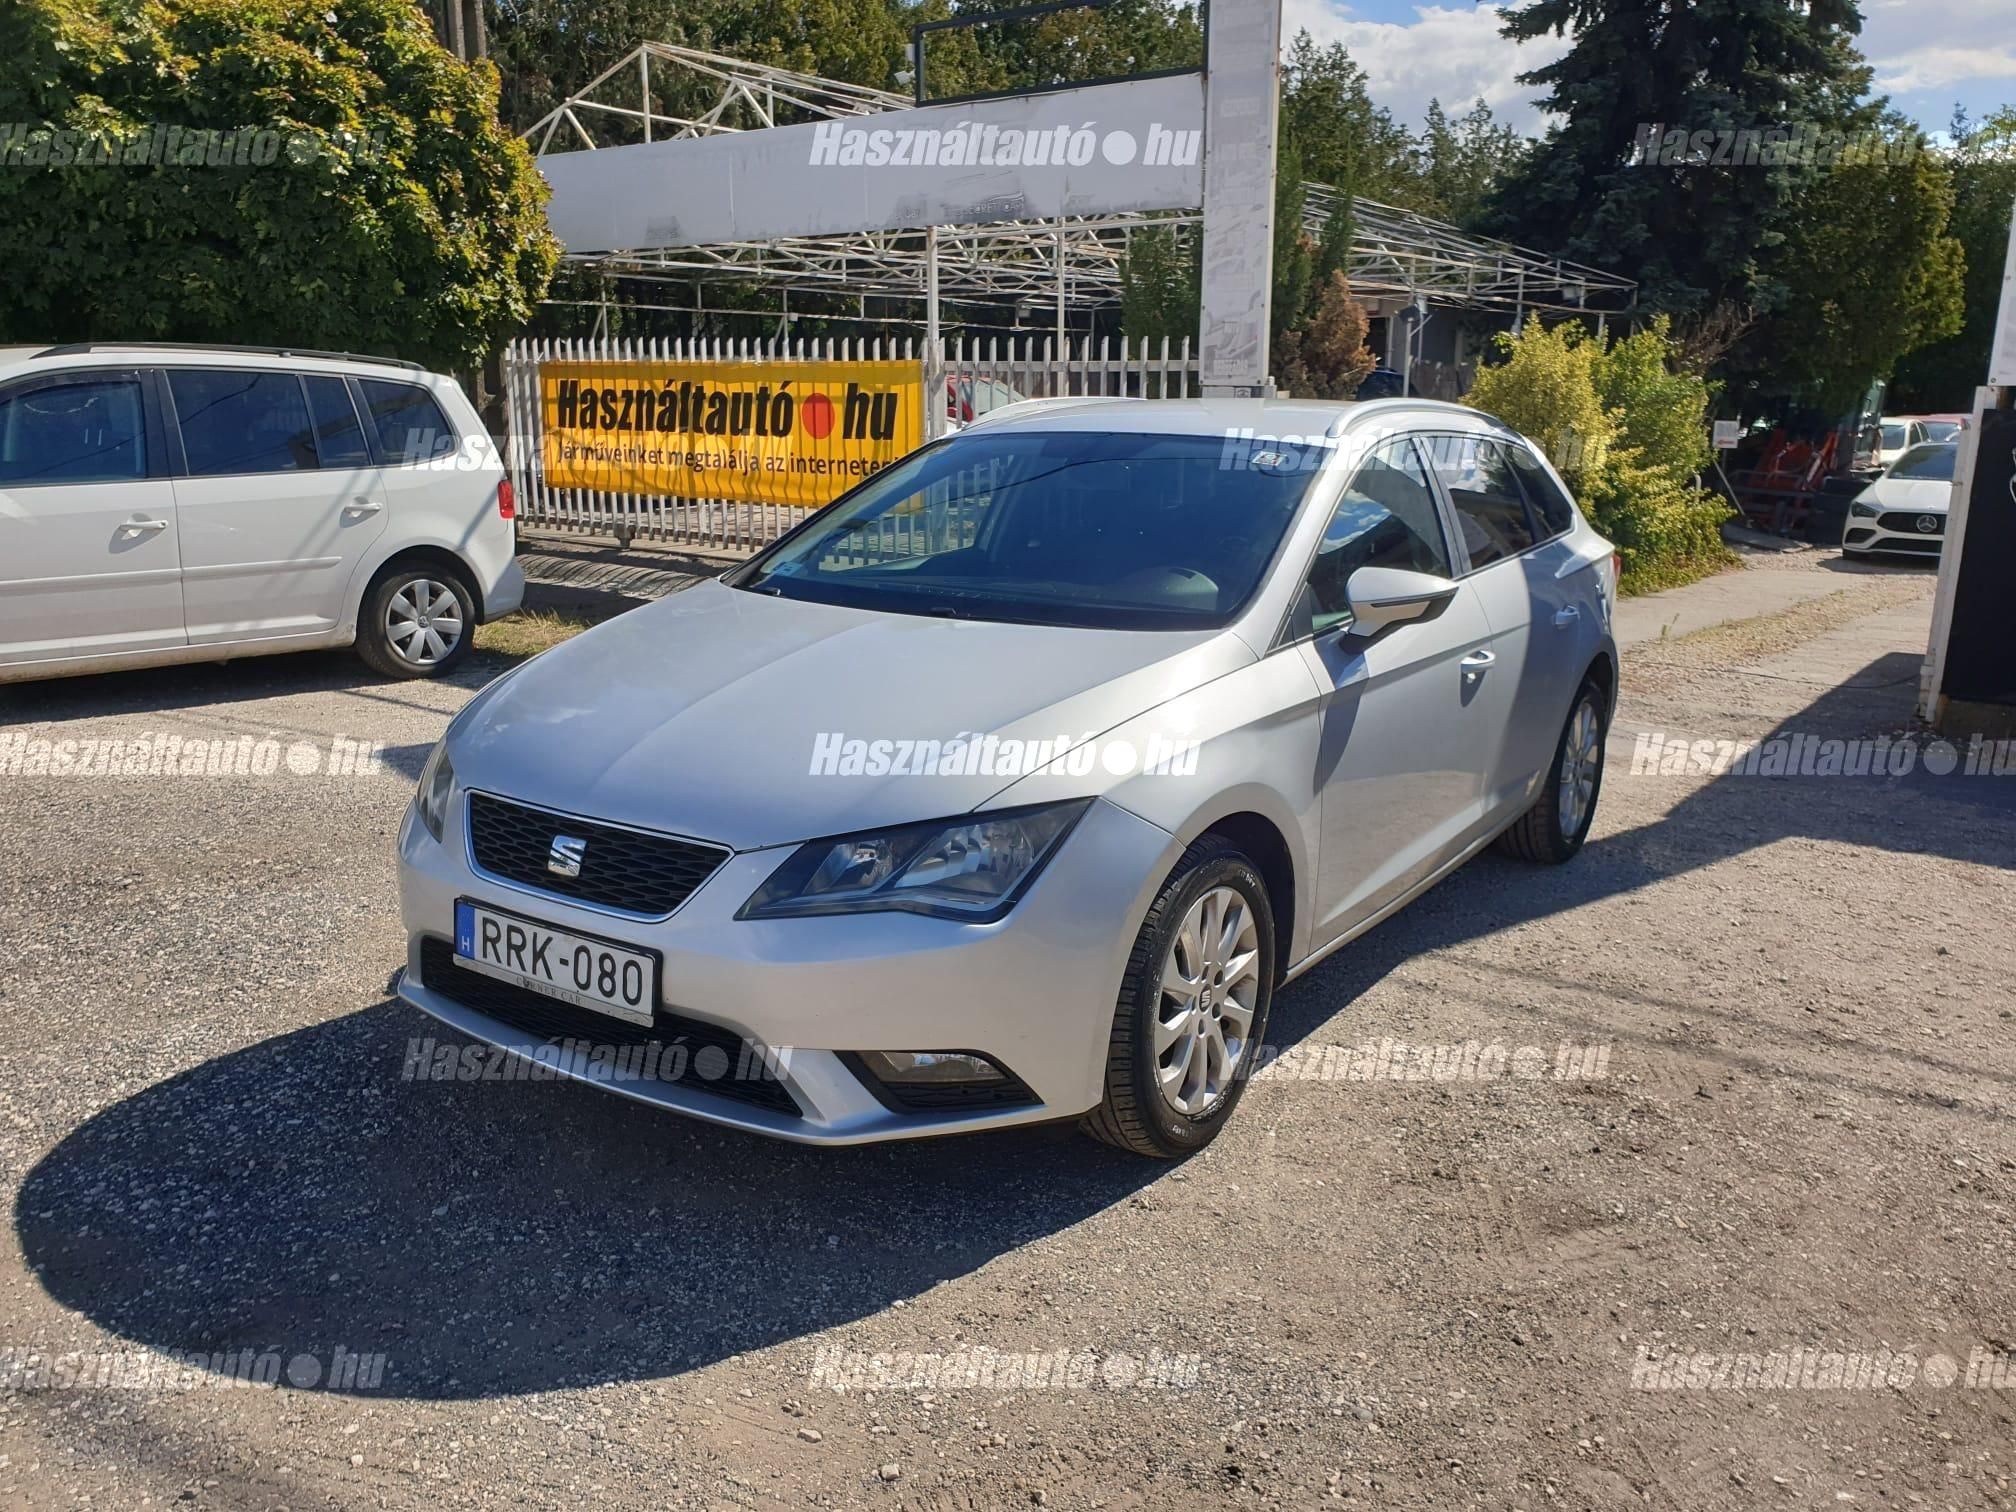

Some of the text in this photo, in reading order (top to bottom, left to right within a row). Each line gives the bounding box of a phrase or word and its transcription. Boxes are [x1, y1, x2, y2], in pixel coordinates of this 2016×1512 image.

[558, 441, 899, 477] Járműveinket megtalálja az internete
[461, 935, 470, 952] H
[482, 916, 643, 1006] RRK-080
